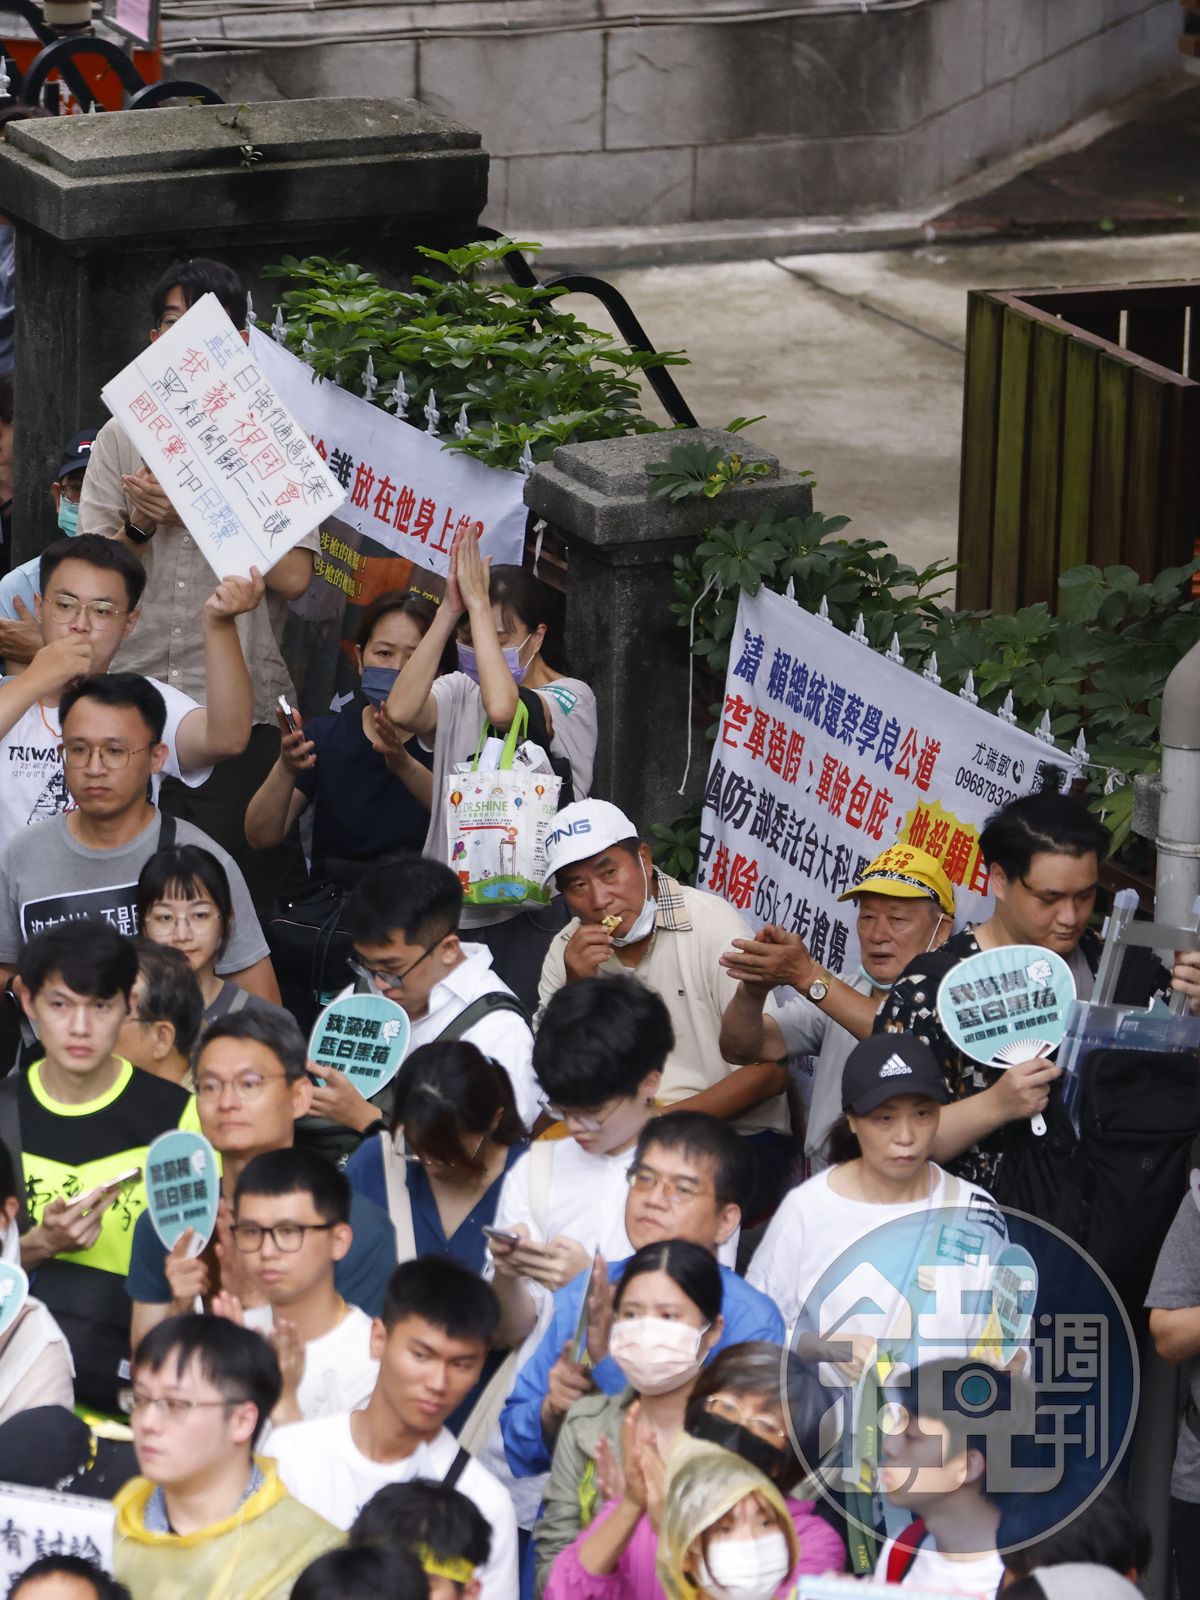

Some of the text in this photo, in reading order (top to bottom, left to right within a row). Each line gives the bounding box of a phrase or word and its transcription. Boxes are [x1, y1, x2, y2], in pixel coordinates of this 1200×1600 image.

[310, 434, 485, 558] 誰放在他身上？
[733, 627, 765, 687] 請
[8, 745, 64, 764] TAIWA
[971, 741, 1013, 779] 尤瑞敏
[544, 818, 592, 857] PING
[325, 1013, 382, 1040] 我藐視
[317, 1035, 391, 1065] 藍白黑箱
[879, 1065, 913, 1078] adidas
